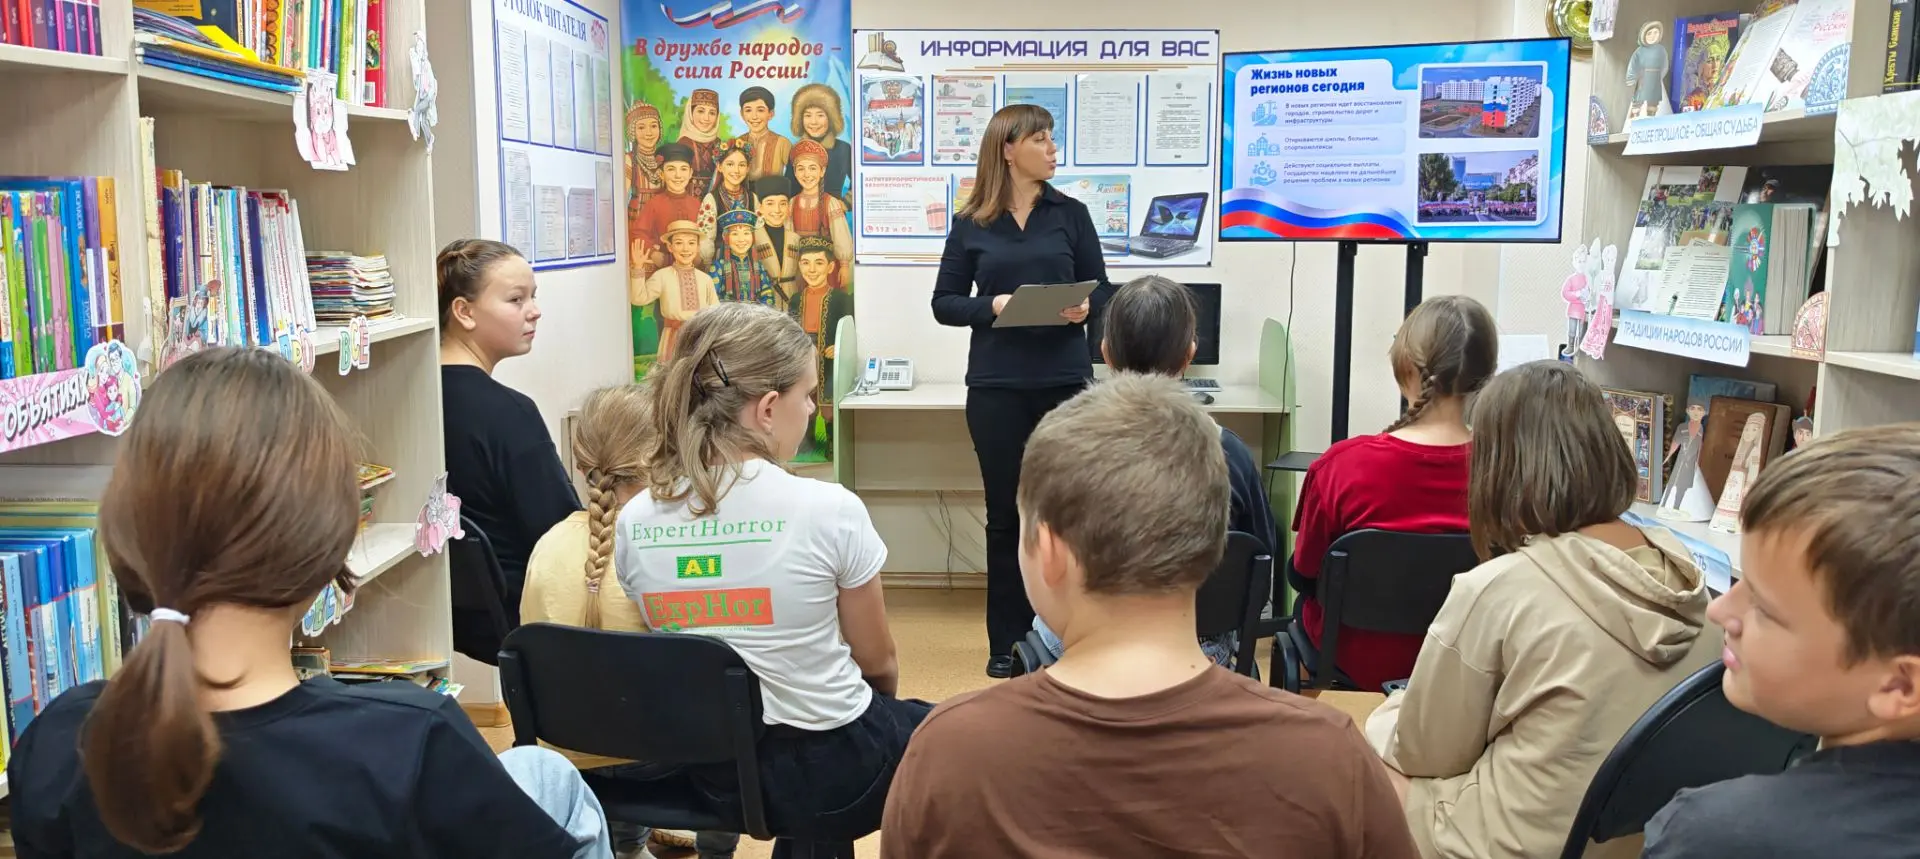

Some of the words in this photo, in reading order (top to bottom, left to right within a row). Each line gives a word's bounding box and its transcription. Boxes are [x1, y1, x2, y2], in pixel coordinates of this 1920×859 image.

[544, 4, 587, 42] ЧИТАТЕЛЯ
[632, 37, 648, 56] В
[654, 37, 732, 61] дружбе
[738, 37, 824, 61] народов
[920, 40, 1088, 60] ИНФОРМАЦИЯ
[1099, 40, 1150, 60] ДЛЯ
[1162, 40, 1210, 57] ВАС
[674, 61, 723, 79] сила
[728, 61, 811, 79] России!
[1251, 69, 1293, 80] Жизнь
[1295, 67, 1338, 79] новых
[1250, 83, 1309, 96] регионов
[1312, 81, 1365, 94] сегодня
[1631, 128, 1655, 145] ОБЩЕЕ
[1655, 124, 1691, 142] ПРОШЛОЕ
[1695, 122, 1723, 139] ОБЩАЯ
[1723, 116, 1758, 135] СУДЬБА
[1624, 321, 1663, 341] ТРАДИЦИИ
[1663, 328, 1704, 348] НАРОДОВ
[1703, 334, 1743, 353] РОССИИ
[4, 371, 90, 442] ОБЪЯТИЯХ
[631, 518, 787, 543] ExpertHorror
[684, 558, 716, 577] AI
[645, 592, 765, 625] ExpHor
